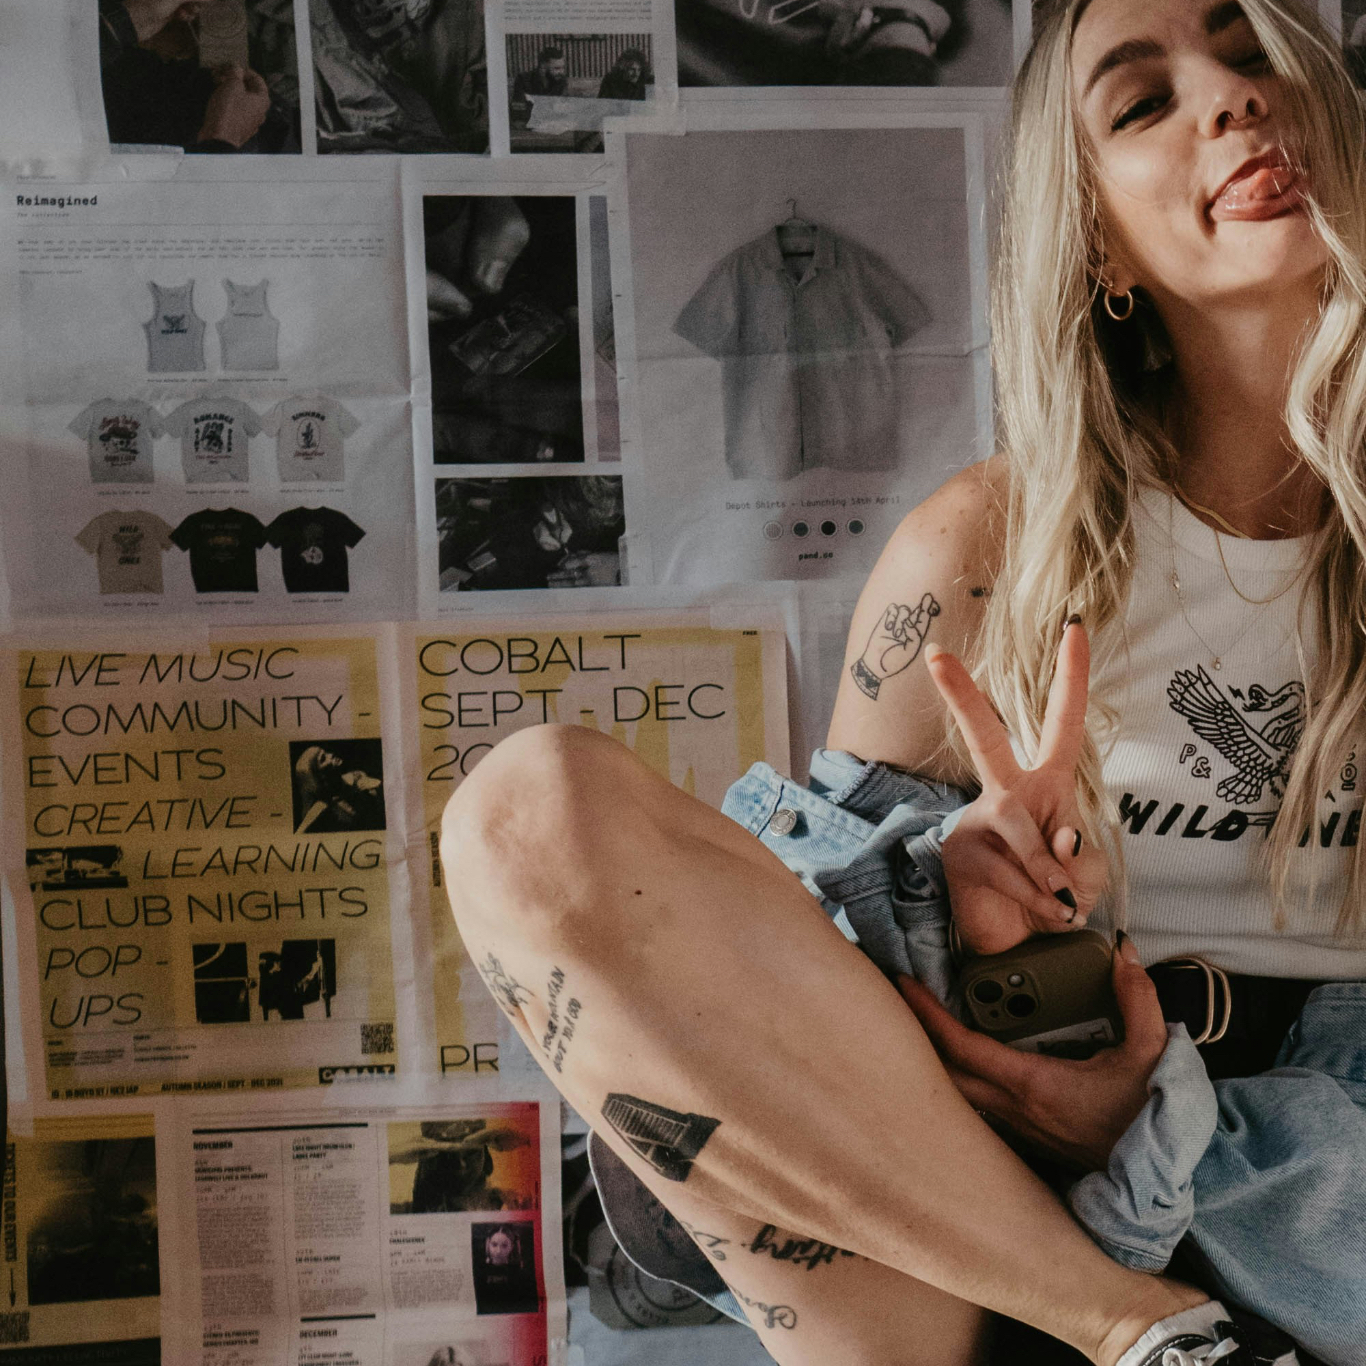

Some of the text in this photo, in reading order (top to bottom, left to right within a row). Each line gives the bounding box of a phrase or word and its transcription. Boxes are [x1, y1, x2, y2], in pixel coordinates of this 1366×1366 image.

[16, 193, 98, 210] Reimagined
[23, 646, 301, 690] LIVE MUSIC
[417, 632, 643, 679] COBALT
[24, 693, 345, 739] COMMUNITY
[419, 681, 729, 731] SEPT DEC
[27, 747, 227, 789] EVENTS
[32, 794, 259, 839] CREATIVE
[1118, 792, 1250, 842] WILD
[141, 838, 385, 881] LEARNING
[39, 886, 370, 932] CLUB NIGHTS
[43, 943, 144, 982] POP
[48, 991, 145, 1029] UPS
